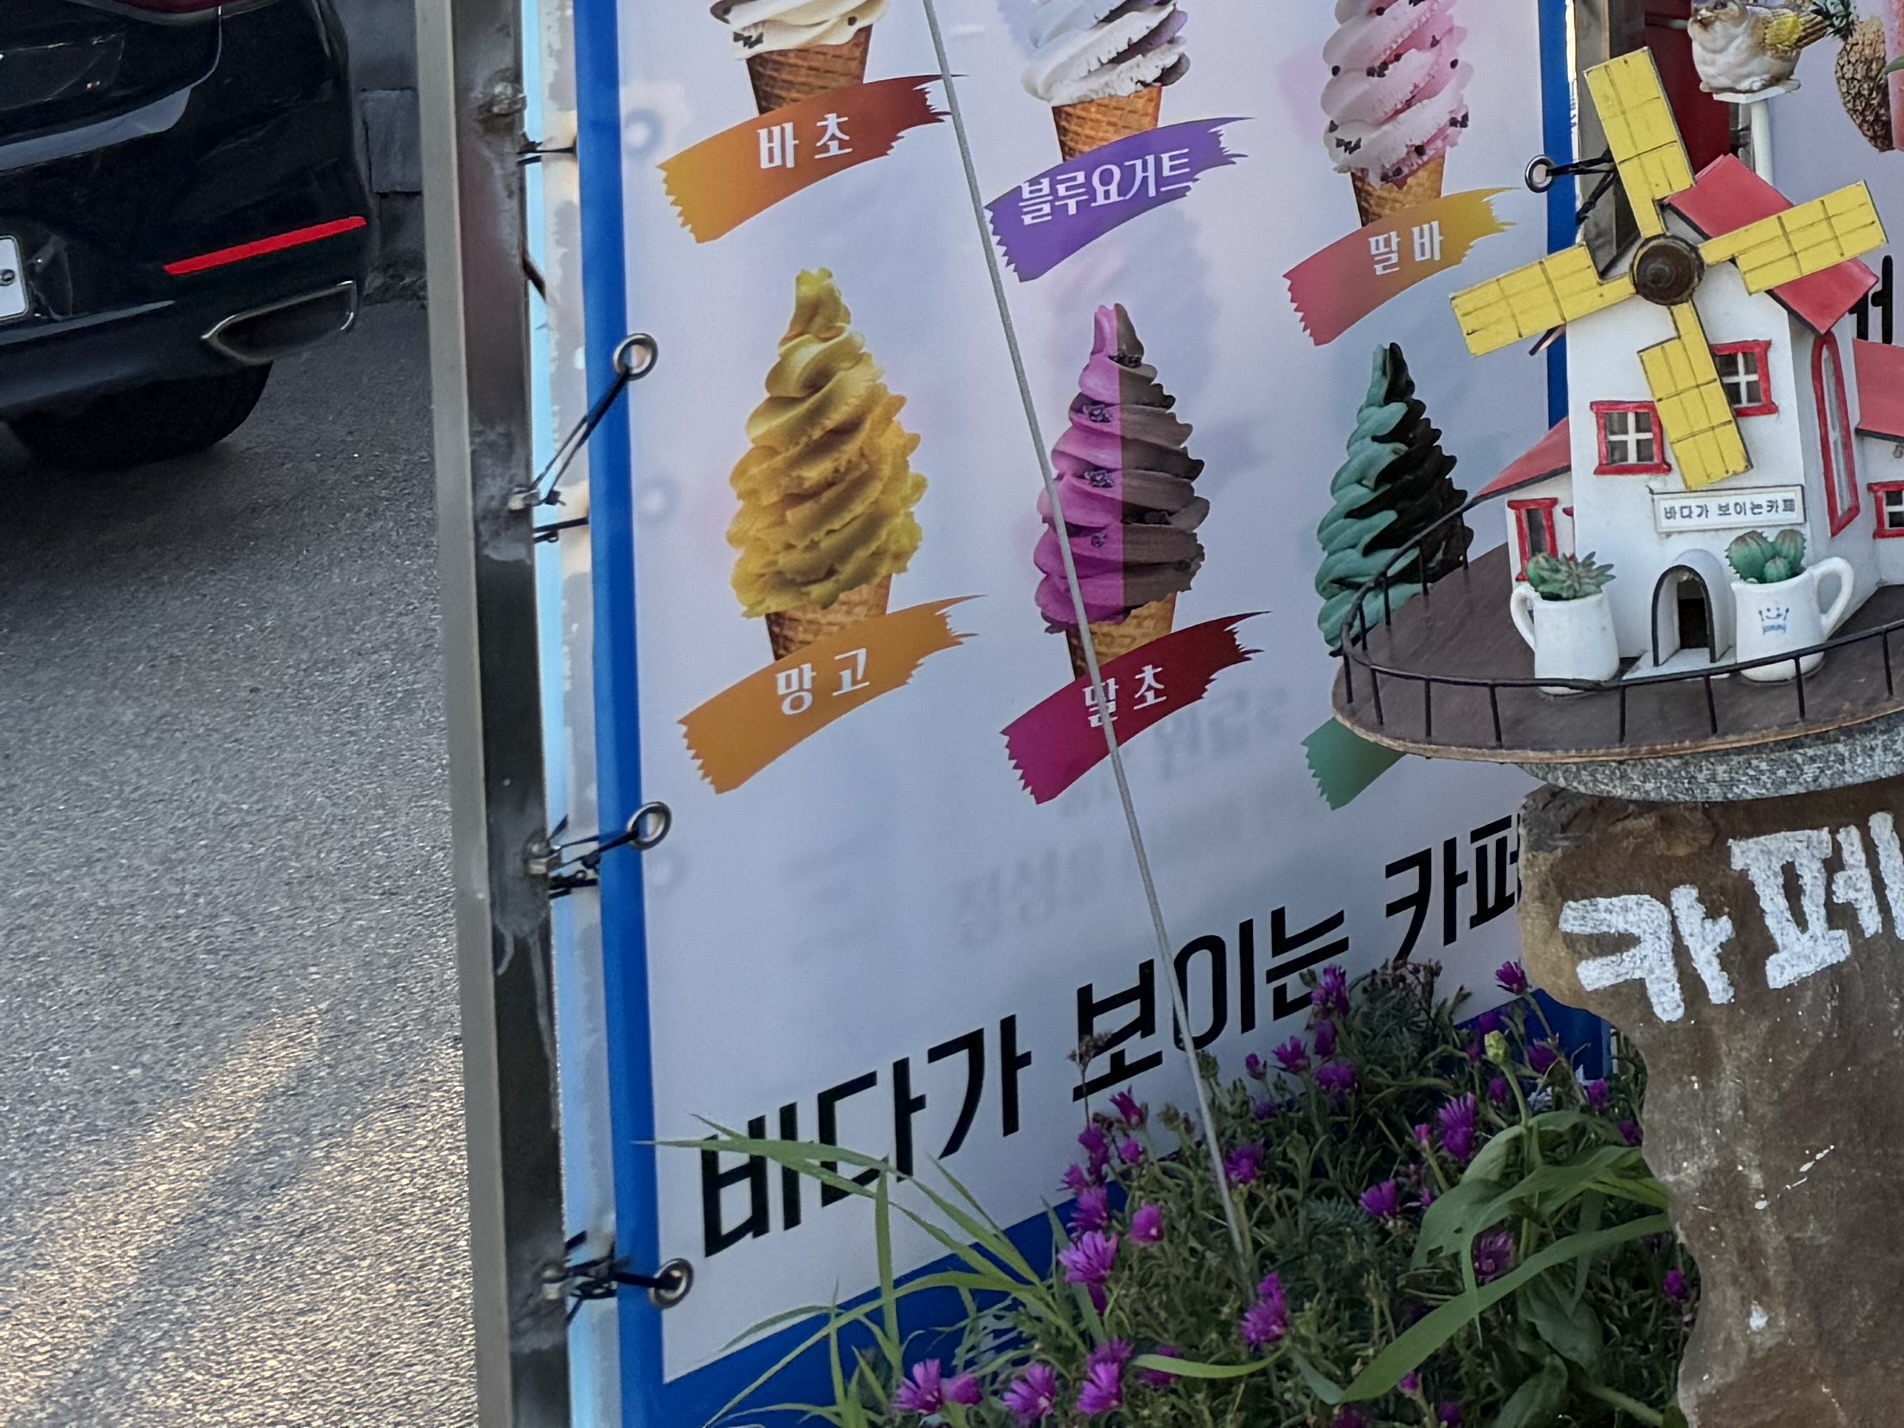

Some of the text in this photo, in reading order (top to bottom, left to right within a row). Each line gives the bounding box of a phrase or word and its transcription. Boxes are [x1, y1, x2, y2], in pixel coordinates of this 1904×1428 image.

[756, 110, 853, 171] 바초
[1018, 147, 1196, 225] 블루요거트
[1366, 222, 1446, 276] 딸바
[1664, 503, 1710, 520] 바다가
[772, 646, 873, 717] 망고
[1082, 663, 1167, 729] 딸초
[698, 1012, 1034, 1258] 바다가
[1072, 905, 1351, 1103] 보이는
